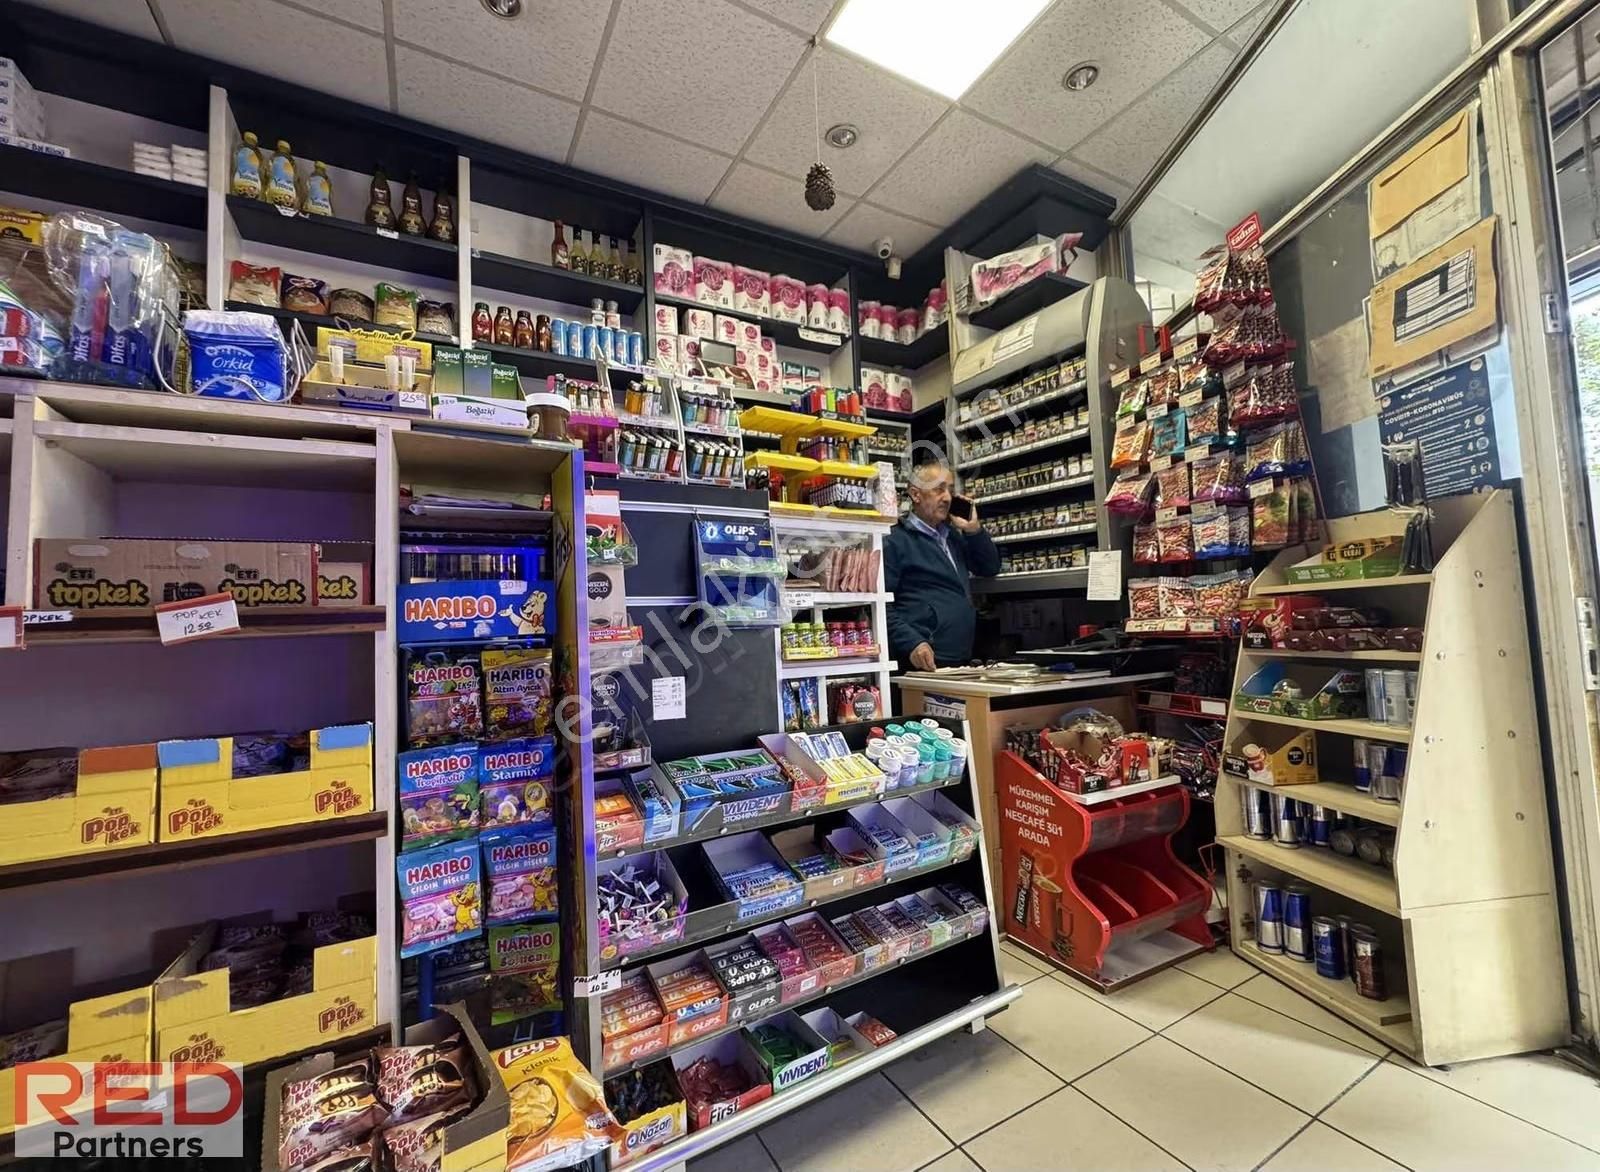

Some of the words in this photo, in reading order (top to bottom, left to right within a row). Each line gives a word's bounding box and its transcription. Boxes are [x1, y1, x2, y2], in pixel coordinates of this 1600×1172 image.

[212, 356, 255, 372] Orkid
[48, 577, 150, 606] topkek
[405, 596, 496, 623] HARIBO
[413, 666, 474, 684] HARIBO
[490, 667, 545, 682] HARIBO
[407, 754, 473, 778] HARIBO
[484, 750, 544, 771] HARIBO
[491, 767, 538, 781] Starmix
[1008, 784, 1056, 807] MÜKEMMEL
[1015, 799, 1049, 817] KARIŞIM
[1005, 808, 1045, 831] NESCAFÉ
[1018, 826, 1051, 848] ARADA
[491, 841, 549, 863] HARIBO
[406, 855, 473, 886] HARIBO
[742, 902, 783, 918] mentos
[496, 932, 553, 953] HARIBO
[521, 1055, 561, 1075] Klasik
[709, 1098, 740, 1125] First
[639, 1117, 672, 1142] Nazar
